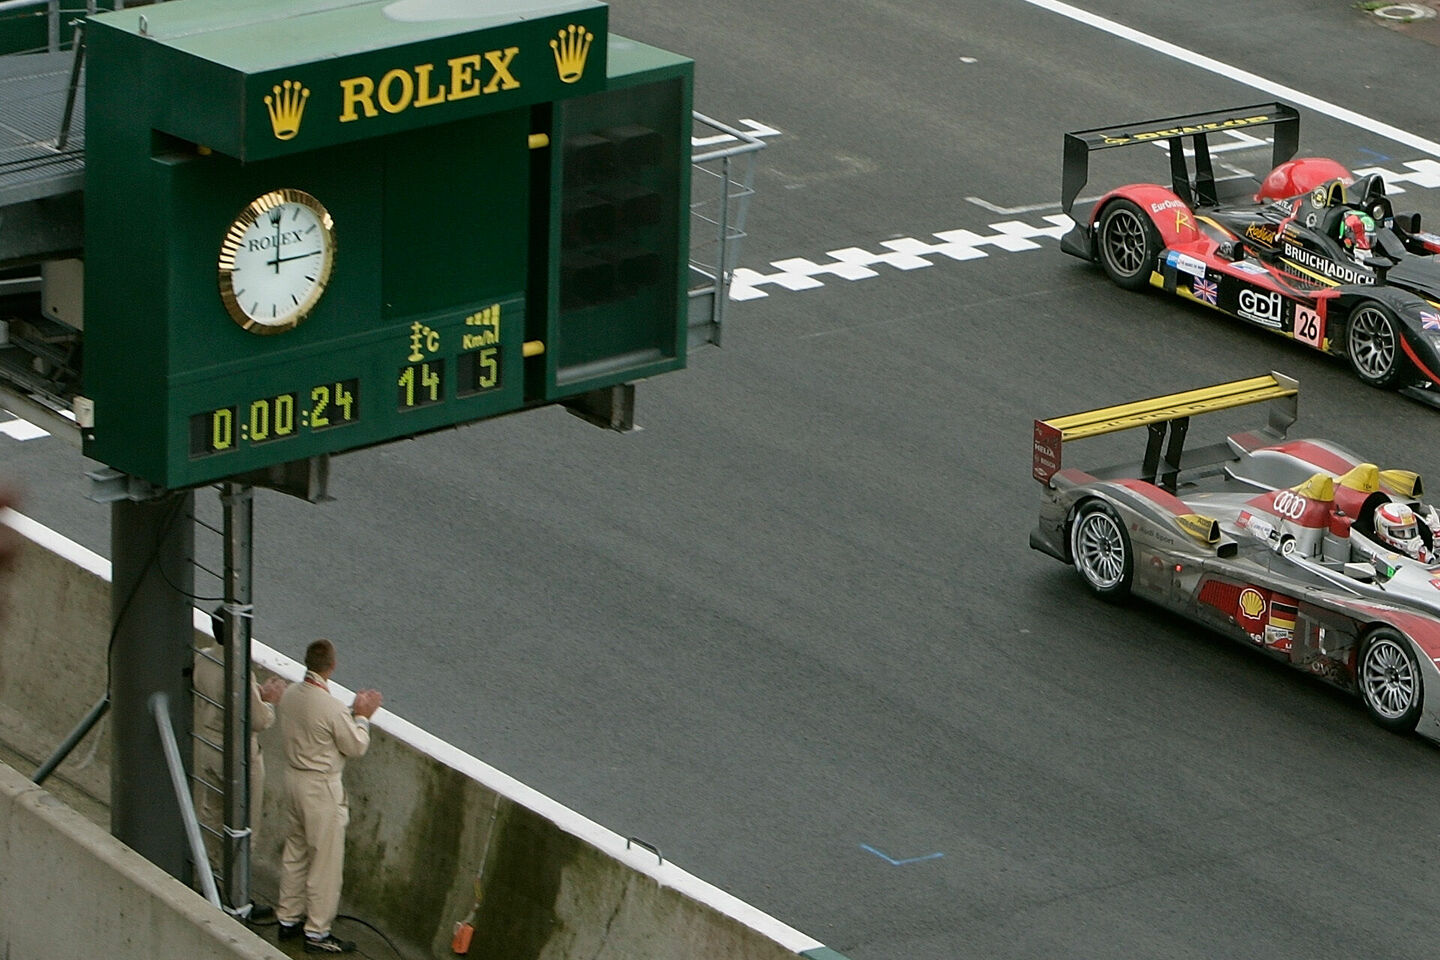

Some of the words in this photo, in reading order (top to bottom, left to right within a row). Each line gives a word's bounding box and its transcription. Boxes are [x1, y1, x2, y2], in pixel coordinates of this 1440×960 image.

[340, 46, 520, 123] ROLEX
[248, 229, 303, 252] ROLEX
[1285, 242, 1375, 285] BRUICHLADDICH
[463, 328, 499, 350] Km/h
[1299, 311, 1317, 340] 26
[398, 364, 439, 406] 14
[479, 348, 497, 388] 5
[212, 382, 353, 450] 0:00:24
